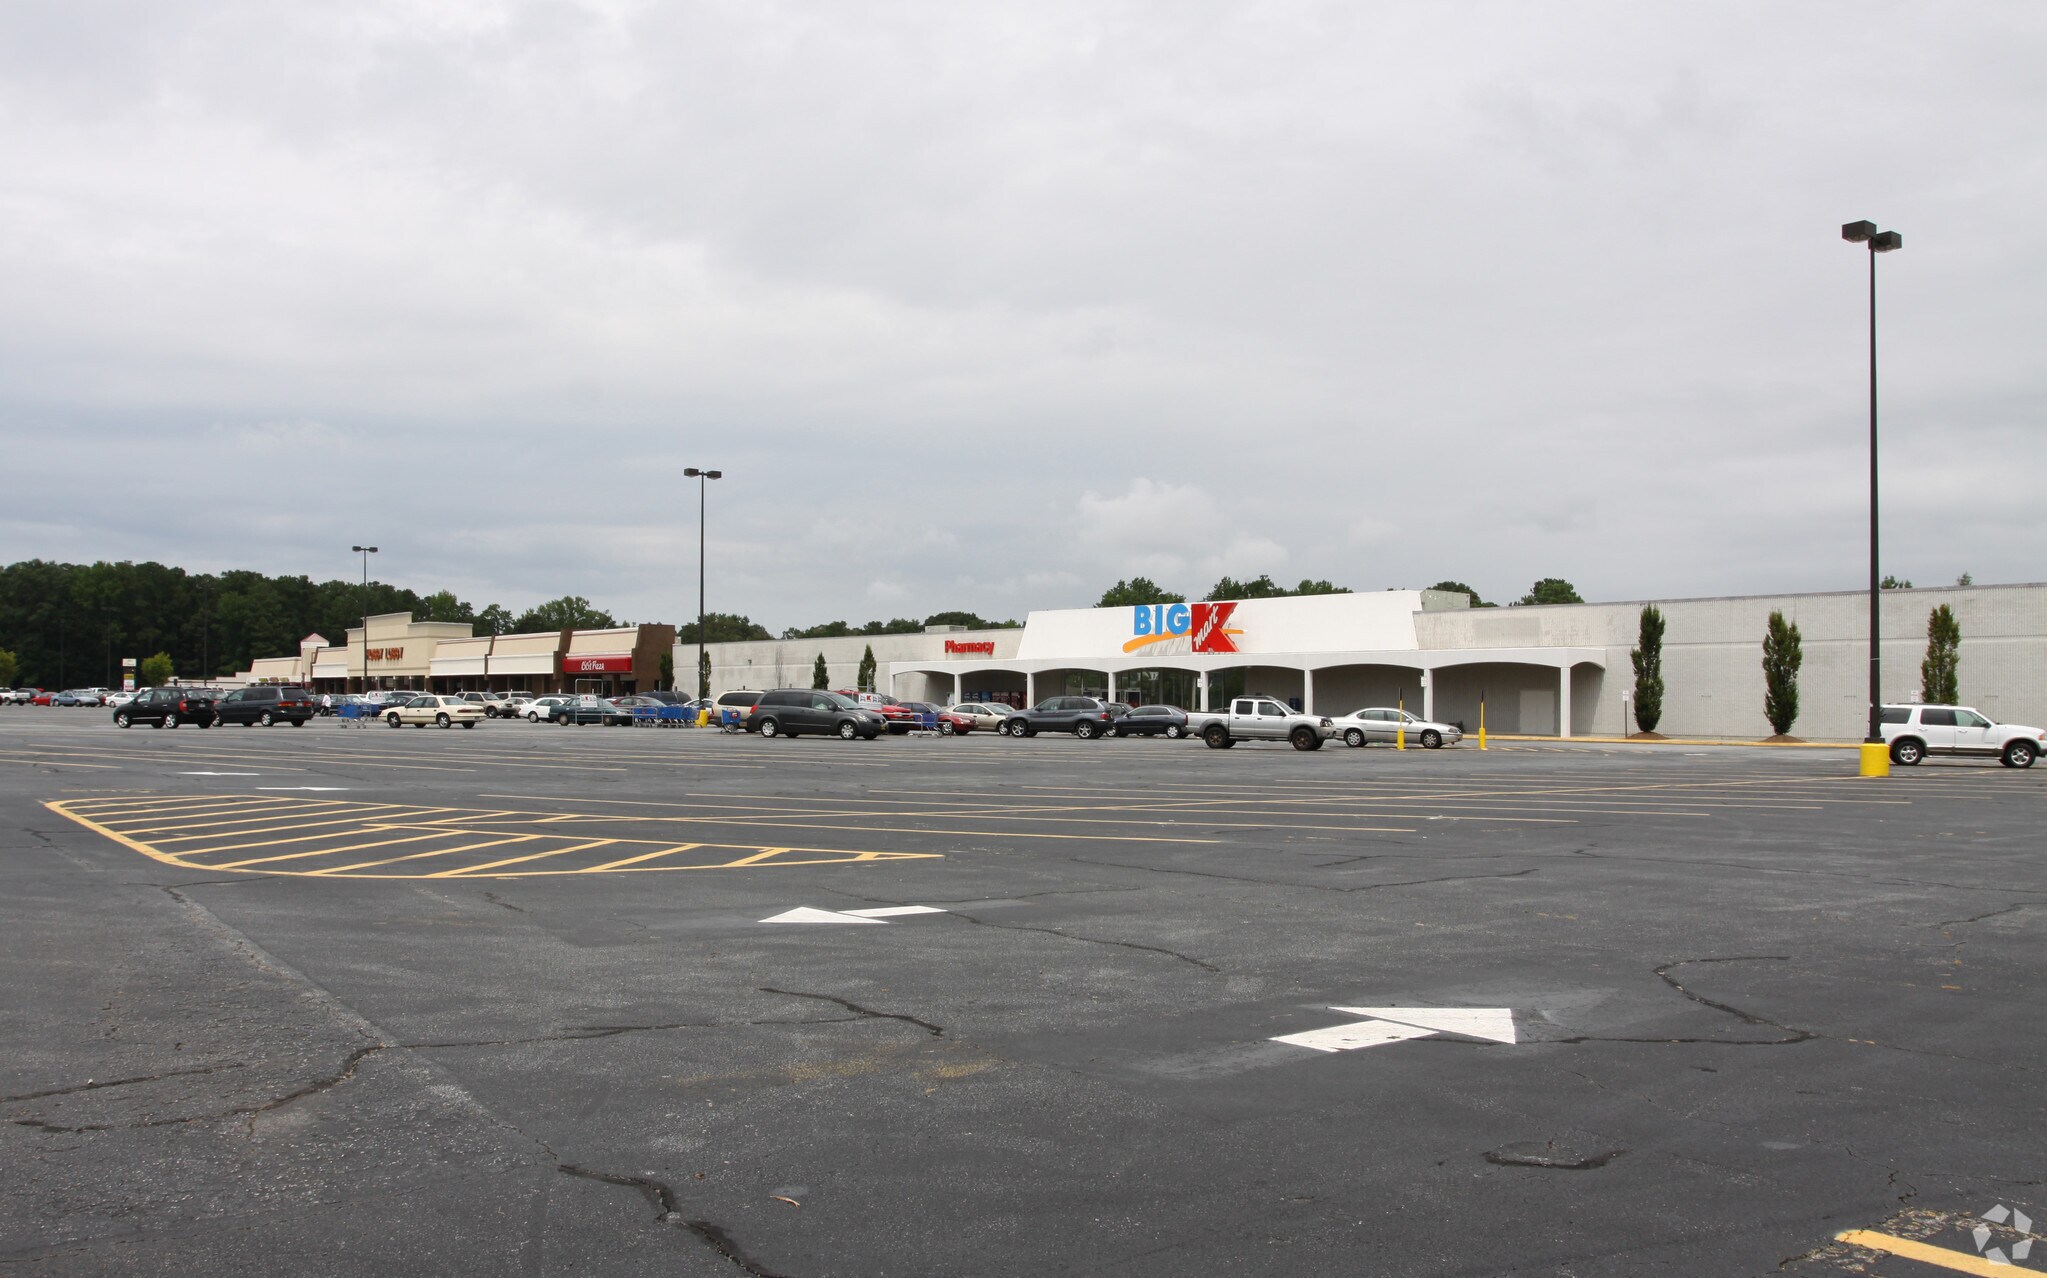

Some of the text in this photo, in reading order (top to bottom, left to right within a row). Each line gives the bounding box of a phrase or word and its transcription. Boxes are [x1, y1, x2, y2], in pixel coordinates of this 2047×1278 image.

[1133, 602, 1240, 653] BIG K
[944, 639, 995, 656] Pharmacy
